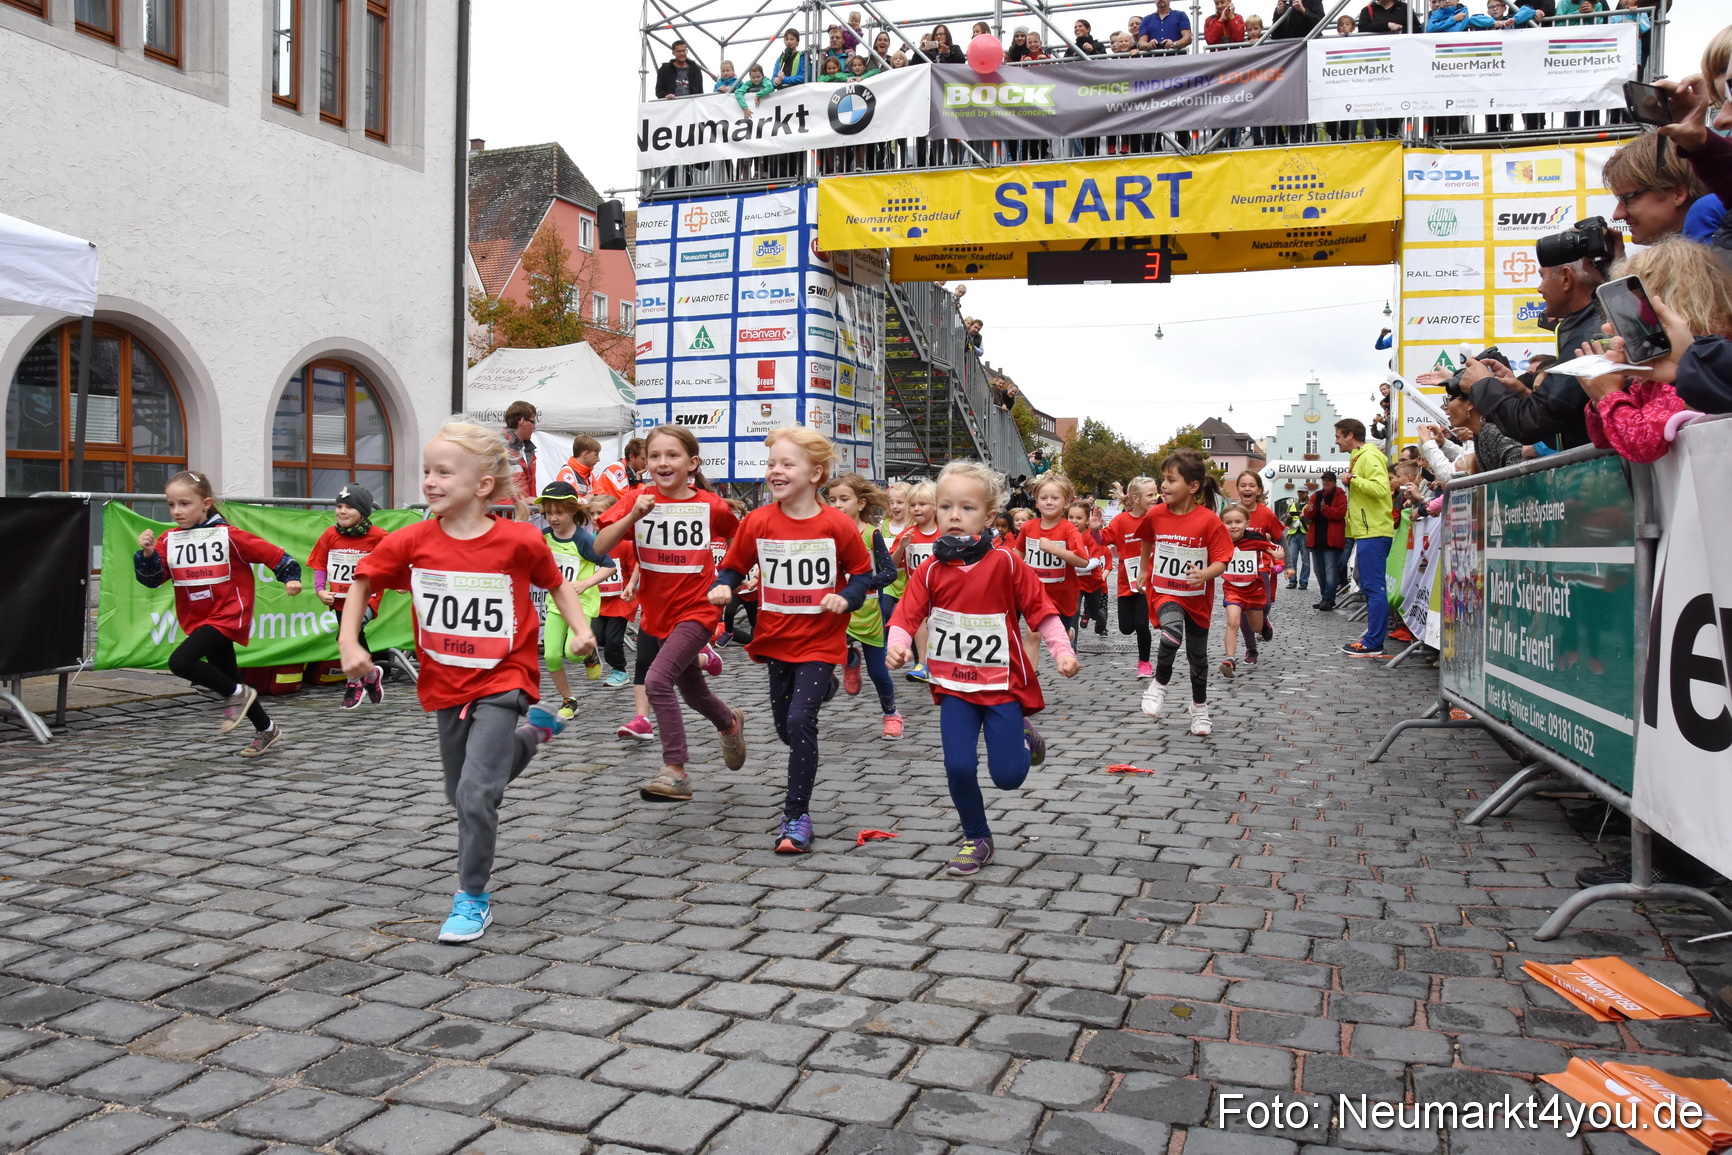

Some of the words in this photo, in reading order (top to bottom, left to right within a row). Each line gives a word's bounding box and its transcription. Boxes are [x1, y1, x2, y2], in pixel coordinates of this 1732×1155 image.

[1431, 59, 1506, 71] NeuerMarkt
[1543, 54, 1621, 68] NeuerMarkt
[1322, 63, 1395, 78] NeuerMarkt
[1077, 82, 1129, 98] OFFICE
[1134, 75, 1215, 93] INDUSTRY
[1219, 67, 1285, 85] LOUNGE
[945, 84, 1053, 107] BOCK
[1105, 90, 1254, 114] www.bockonline.de
[942, 109, 977, 119] inspired
[978, 109, 988, 120] by
[990, 109, 1016, 118] smart
[1017, 109, 1056, 119] concepts
[637, 104, 809, 153] Neumarkt
[1444, 180, 1480, 189] energie
[1537, 174, 1560, 182] KANN
[993, 170, 1194, 228] START
[1230, 192, 1303, 206] Neumarkter
[1306, 186, 1366, 203] Stadtlauf
[710, 210, 728, 218] CODE
[710, 216, 731, 225] CLINIC
[744, 211, 782, 221] RAIL.ONE
[845, 211, 908, 225] Neumarkter
[911, 209, 961, 223] Stadtlauf
[1497, 211, 1548, 226] swn
[636, 219, 669, 230] ARIOTEC
[1250, 239, 1315, 251] Neumarkter
[1316, 233, 1367, 247] Stadtlauf
[912, 252, 968, 263] Neumarkter
[970, 251, 1014, 261] Stadtlauf
[1143, 252, 1160, 280] 3
[1406, 270, 1459, 279] RAIL.ONE
[691, 293, 730, 304] VARIOTEC
[769, 297, 796, 306] energie
[1425, 314, 1481, 326] VARIOTEC
[636, 377, 664, 388] ARIOTEC
[674, 378, 712, 386] RAIL.ONE
[675, 413, 709, 425] swn
[746, 425, 772, 434] Lamms
[700, 457, 727, 467] IOTEC
[1278, 464, 1307, 474] BMW
[1504, 499, 1565, 529] Event-Leit-Systeme
[642, 519, 704, 547] 7168
[174, 541, 225, 565] 7013
[790, 541, 830, 553] BOCK
[657, 552, 687, 566] Helga
[1226, 559, 1254, 573] 139
[185, 568, 213, 580] Sophia
[765, 557, 831, 586] 7109
[453, 575, 506, 591] BOCK
[1167, 580, 1189, 590] Marie
[782, 592, 812, 604] Laura
[1490, 569, 1515, 607] Mehr
[1515, 571, 1571, 619] Sicherheit
[422, 592, 504, 633] 7045
[443, 638, 475, 655] Frida
[935, 626, 1002, 665] 7122
[1488, 616, 1503, 653] für
[1503, 620, 1518, 658] Ihr
[1519, 626, 1555, 672] Event!
[951, 666, 979, 682] Anna
[1487, 683, 1501, 709] Miet
[1501, 691, 1507, 711] &
[1507, 693, 1529, 723] Service
[1529, 703, 1547, 733] Line:
[1547, 712, 1572, 746] 09181
[1573, 723, 1596, 758] 6352
